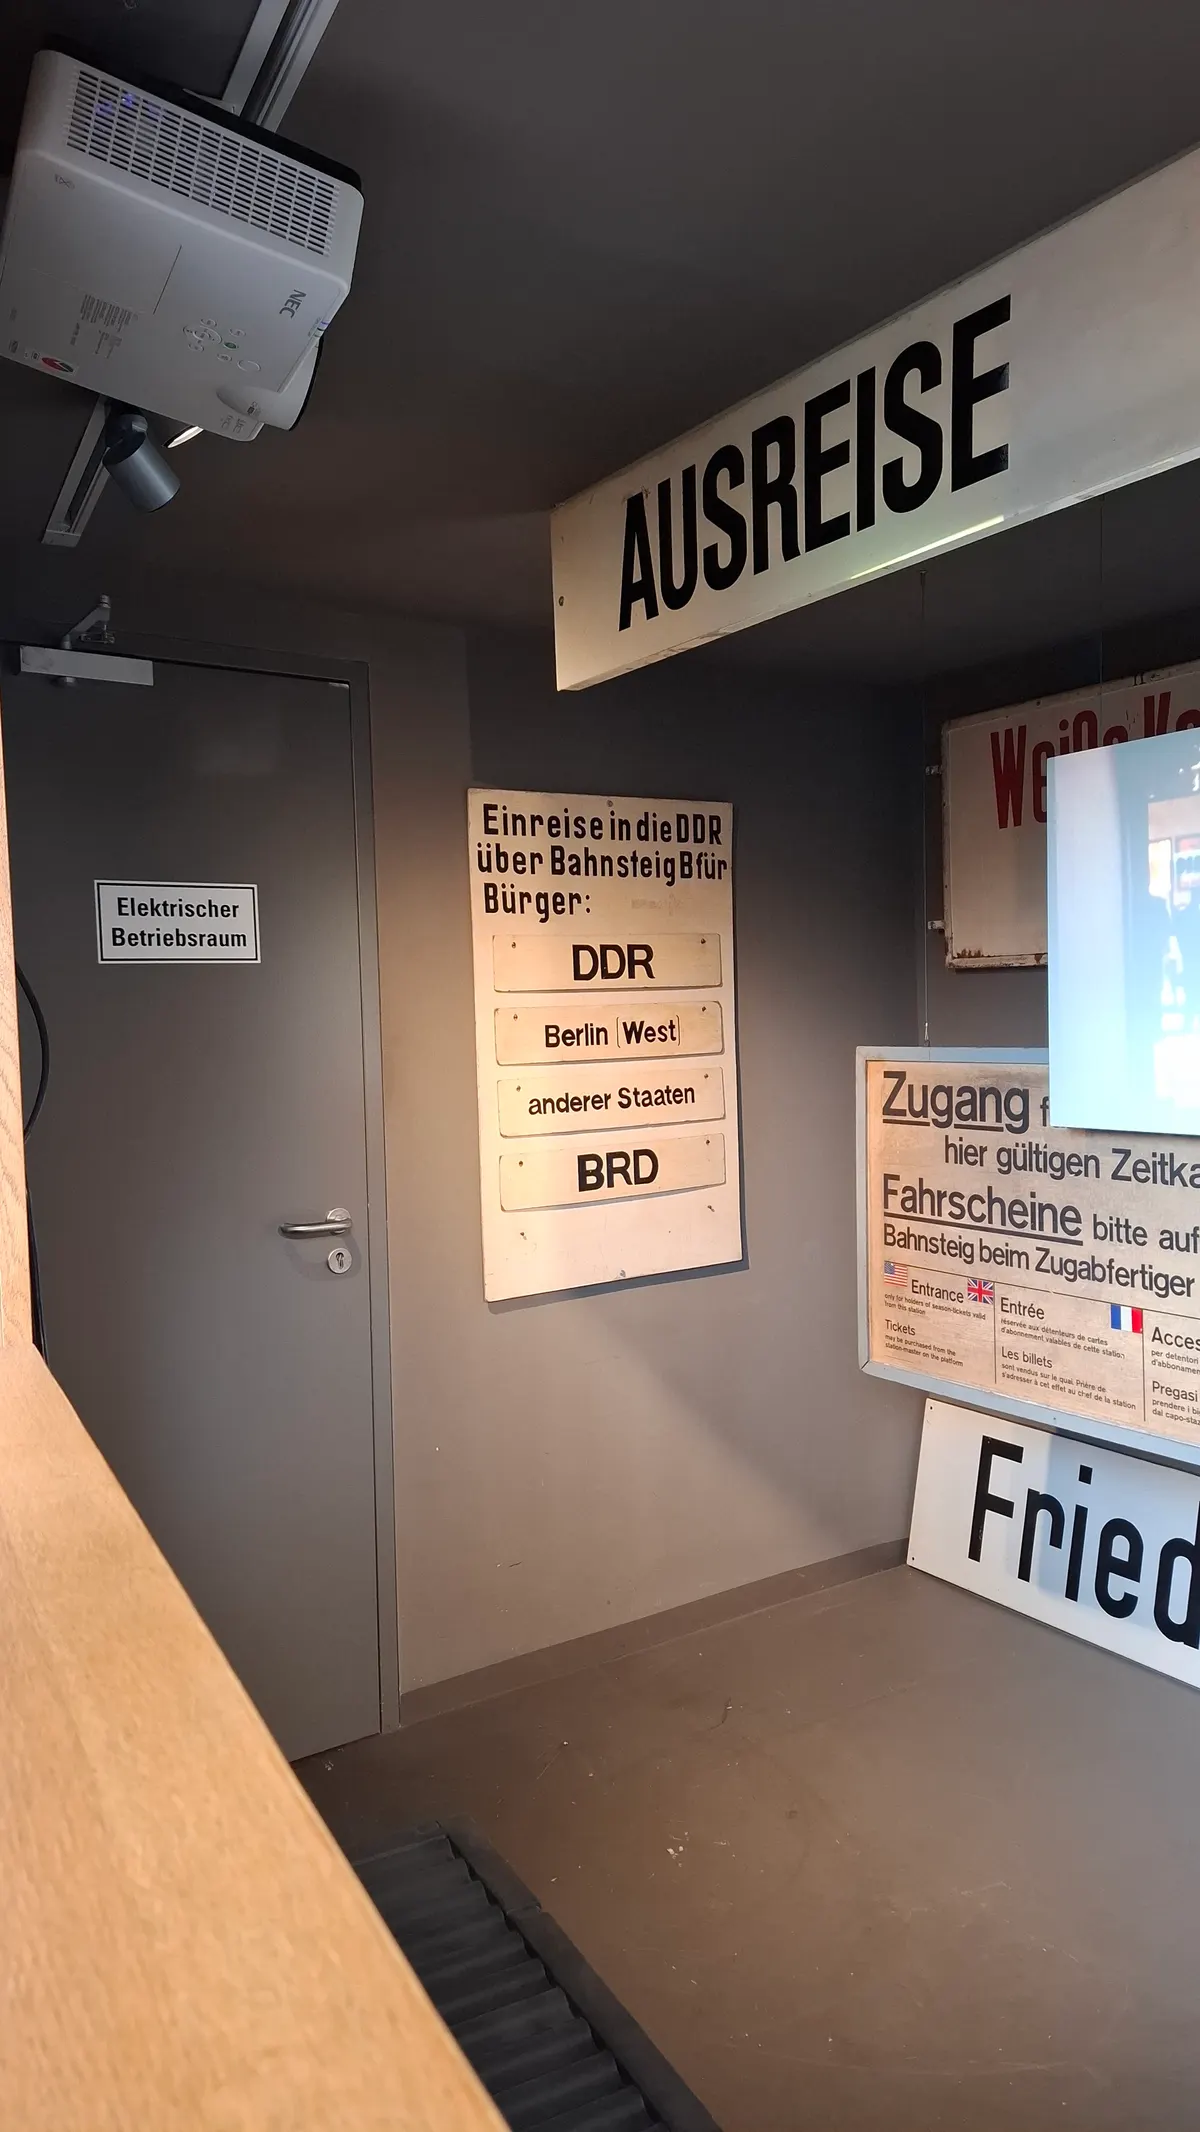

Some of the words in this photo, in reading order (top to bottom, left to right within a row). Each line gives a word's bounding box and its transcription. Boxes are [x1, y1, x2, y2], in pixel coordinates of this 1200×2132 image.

[279, 289, 307, 319] NEC
[618, 294, 1012, 631] AUSREISE
[482, 803, 604, 840] Einreise
[609, 810, 631, 842] in
[636, 812, 672, 844] die
[675, 813, 723, 846] DDR
[477, 842, 544, 876] über
[550, 845, 676, 887] Bahnsteig
[679, 850, 693, 880] B
[696, 851, 728, 880] für
[116, 897, 240, 918] Elektrischer
[483, 882, 592, 924] Bürger:
[111, 927, 247, 947] Betriebsraum
[571, 943, 656, 981] DDR
[544, 1023, 609, 1048] Berlin
[528, 1092, 611, 1116] anderer
[617, 1084, 695, 1110] Staaten
[882, 1070, 1030, 1134] Zugang
[577, 1148, 659, 1193] BRD
[944, 1135, 988, 1167] hier
[996, 1141, 1100, 1181] gültigen
[1111, 1147, 1200, 1190] Zeitka
[883, 1173, 1083, 1237] Fahrscheine
[1093, 1213, 1148, 1247] bitte
[1158, 1225, 1200, 1254] auf
[883, 1223, 975, 1265] Bahnsteig
[979, 1237, 1030, 1271] beim
[1035, 1247, 1195, 1298] Zugabfertiger
[911, 1279, 965, 1304] Entrance
[884, 1293, 895, 1301] only
[904, 1296, 924, 1306] holders
[972, 1311, 986, 1320] valid
[897, 1303, 907, 1311] this
[908, 1306, 926, 1316] station
[1000, 1296, 1045, 1320] Entrée
[884, 1318, 916, 1336] Tickets
[1000, 1318, 1027, 1329] réservée
[1028, 1323, 1040, 1332] aux
[1041, 1324, 1076, 1340] détenteurs
[1076, 1333, 1086, 1342] de
[1087, 1336, 1108, 1346] cartes
[884, 1334, 896, 1343] may
[896, 1335, 904, 1343] be
[904, 1338, 932, 1351] purchased
[933, 1344, 946, 1354] from
[946, 1348, 956, 1357] the
[1001, 1346, 1020, 1361] Les
[1022, 1351, 1053, 1369] billets
[1045, 1336, 1072, 1348] valables
[1072, 1341, 1082, 1350] de
[1083, 1343, 1100, 1354] cette
[1151, 1350, 1163, 1358] per
[1165, 1350, 1199, 1365] detentori
[930, 1352, 940, 1361] the
[940, 1356, 964, 1368] platform
[1001, 1363, 1015, 1372] sont
[1016, 1365, 1039, 1377] vendus
[1040, 1371, 1050, 1379] sur
[1051, 1373, 1058, 1381] le
[1076, 1379, 1096, 1391] Prière
[1097, 1384, 1106, 1393] de
[1152, 1380, 1198, 1403] Pregasi
[1039, 1381, 1050, 1389] cet
[1067, 1387, 1076, 1395] au
[1093, 1393, 1103, 1402] de
[1104, 1396, 1111, 1405] la
[1112, 1399, 1137, 1411] station
[1152, 1399, 1186, 1412] prendere
[968, 1434, 1200, 1650] Fried
